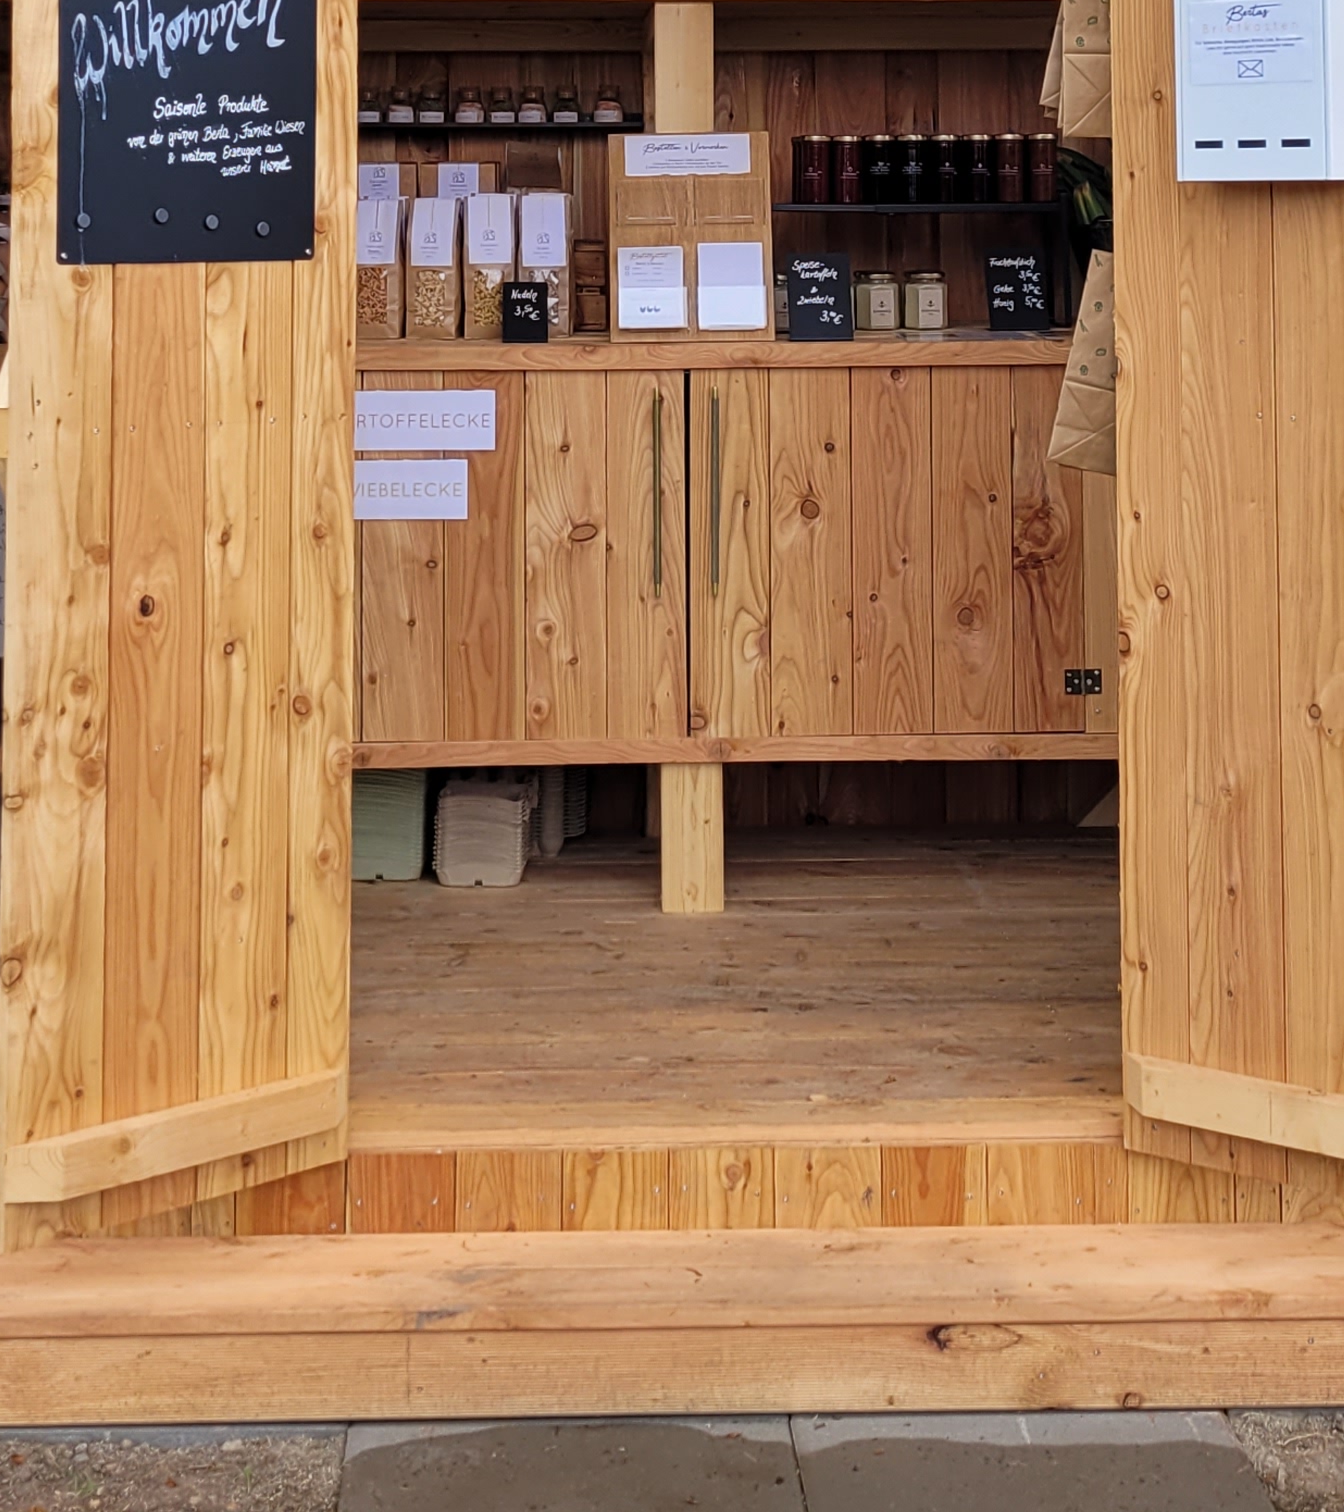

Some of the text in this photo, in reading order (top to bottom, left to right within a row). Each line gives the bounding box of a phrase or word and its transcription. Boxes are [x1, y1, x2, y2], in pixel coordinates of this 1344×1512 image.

[218, 93, 270, 115] Produkte
[149, 129, 164, 146] der
[356, 413, 491, 429] RTOFFELECKE
